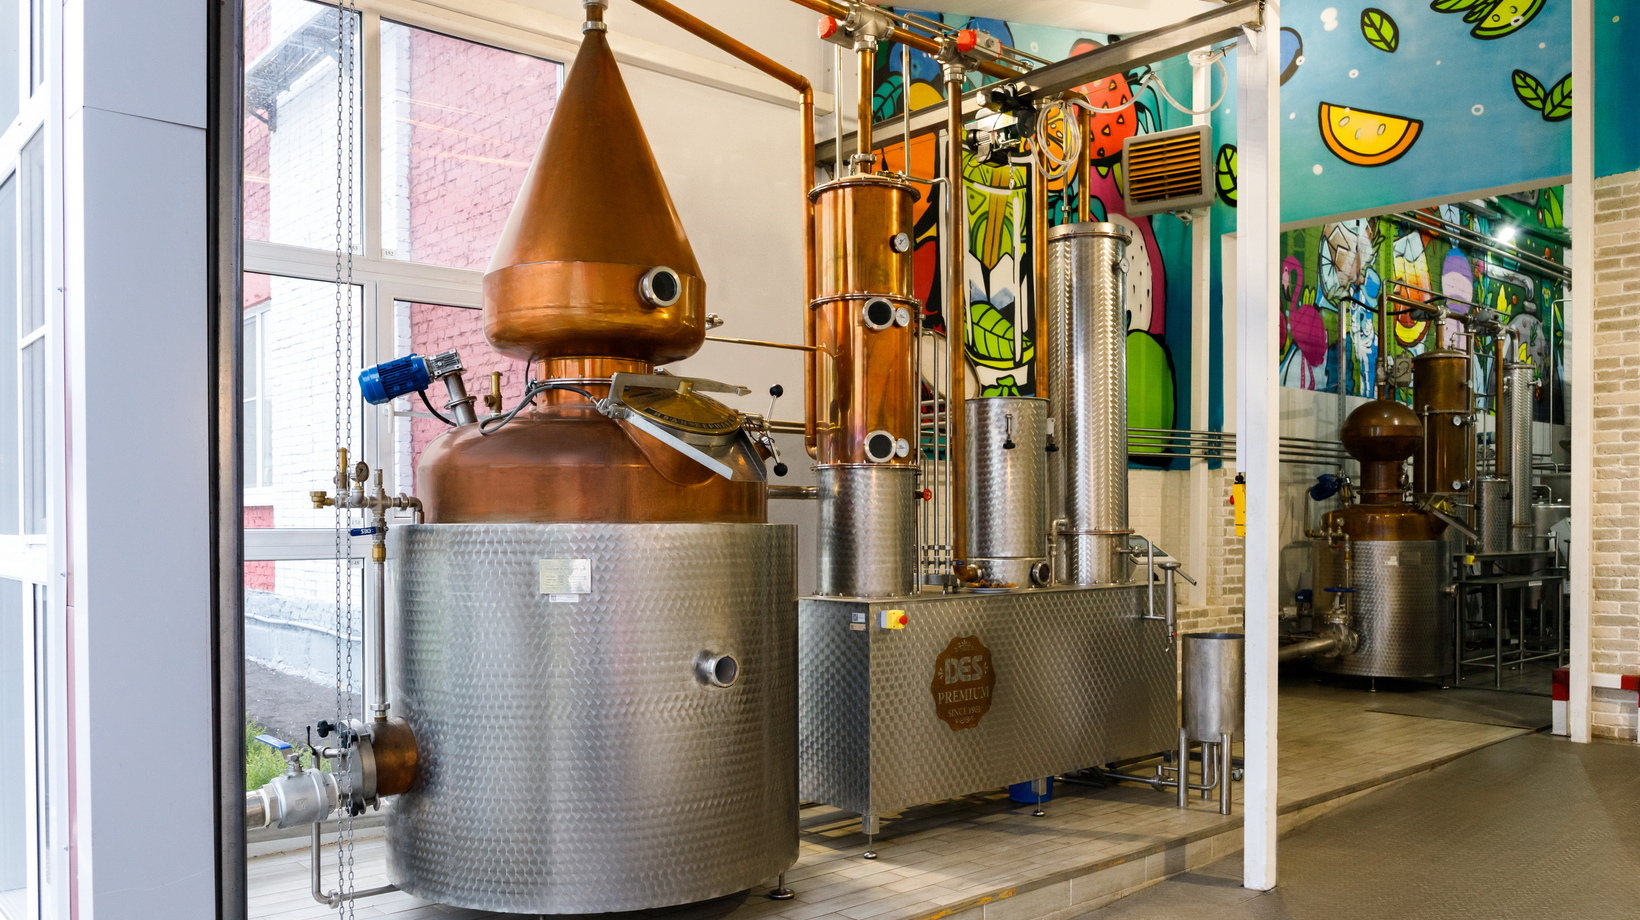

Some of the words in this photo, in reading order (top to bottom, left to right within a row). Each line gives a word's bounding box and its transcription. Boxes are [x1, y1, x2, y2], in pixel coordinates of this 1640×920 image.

[945, 655, 983, 685] DES
[938, 686, 989, 704] PREMIUM
[948, 707, 967, 717] SINCE
